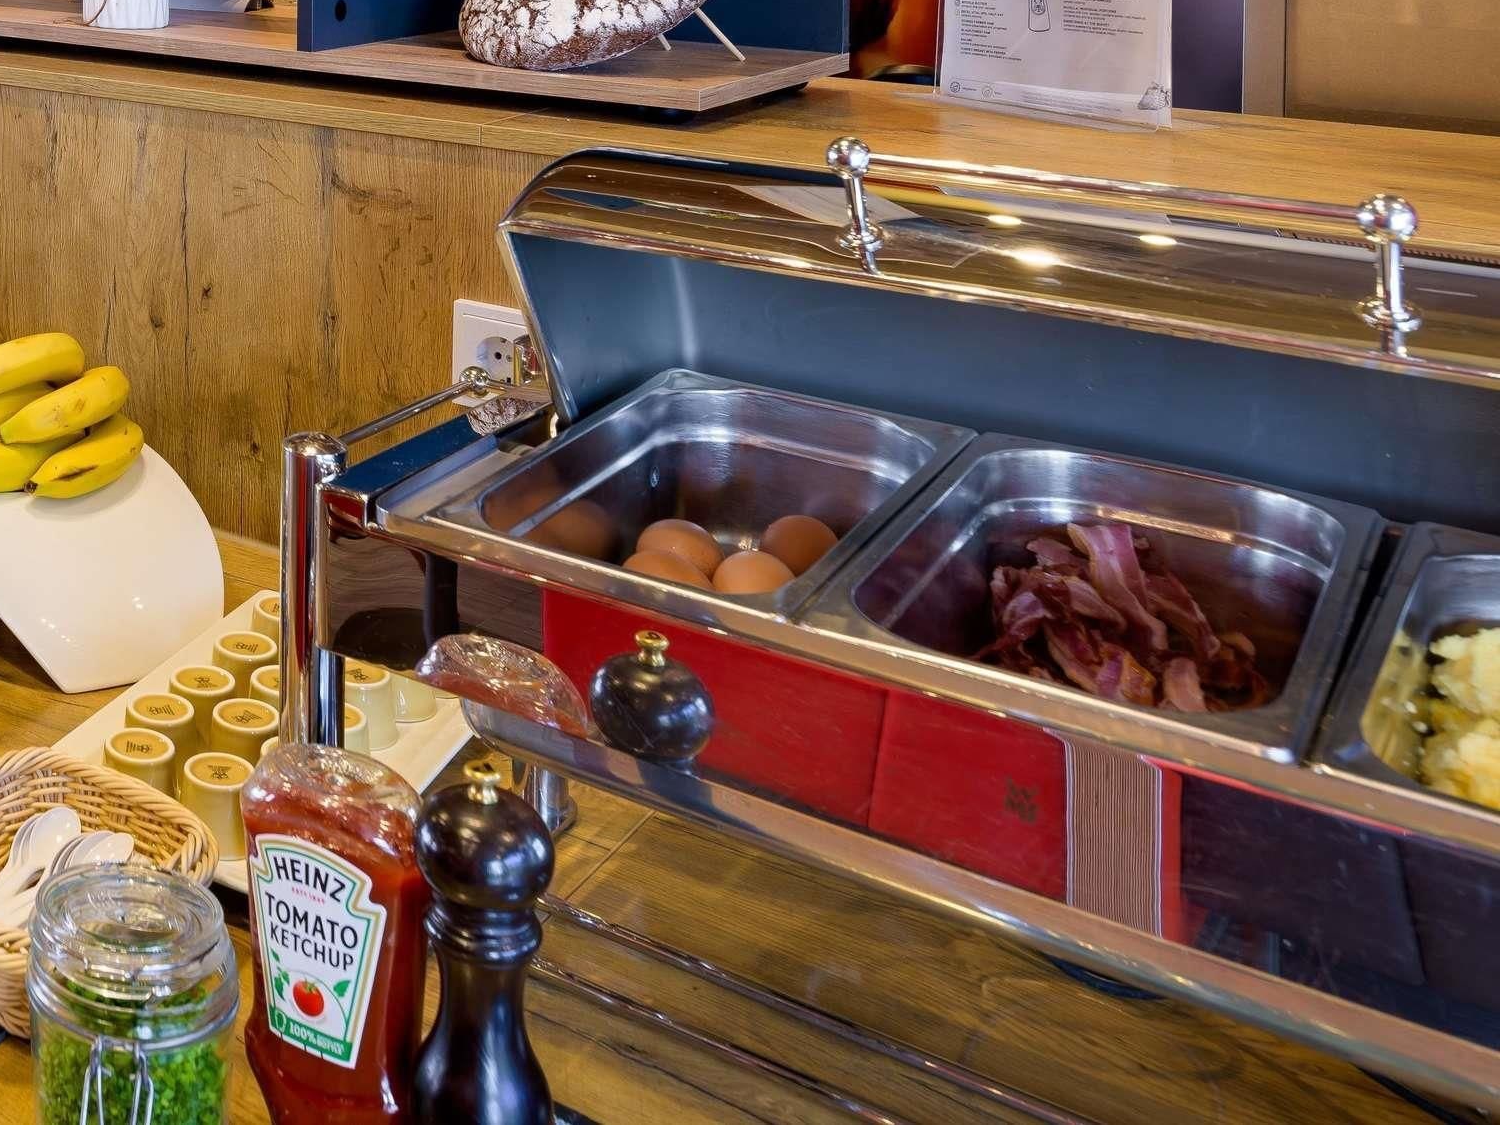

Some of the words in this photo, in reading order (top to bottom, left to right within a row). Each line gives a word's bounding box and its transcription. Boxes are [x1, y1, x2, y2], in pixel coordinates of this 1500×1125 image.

[273, 856, 346, 903] HEINZ
[264, 891, 358, 949] TOMATO
[270, 924, 354, 971] KETCHUP
[290, 1021, 317, 1045] 100%
